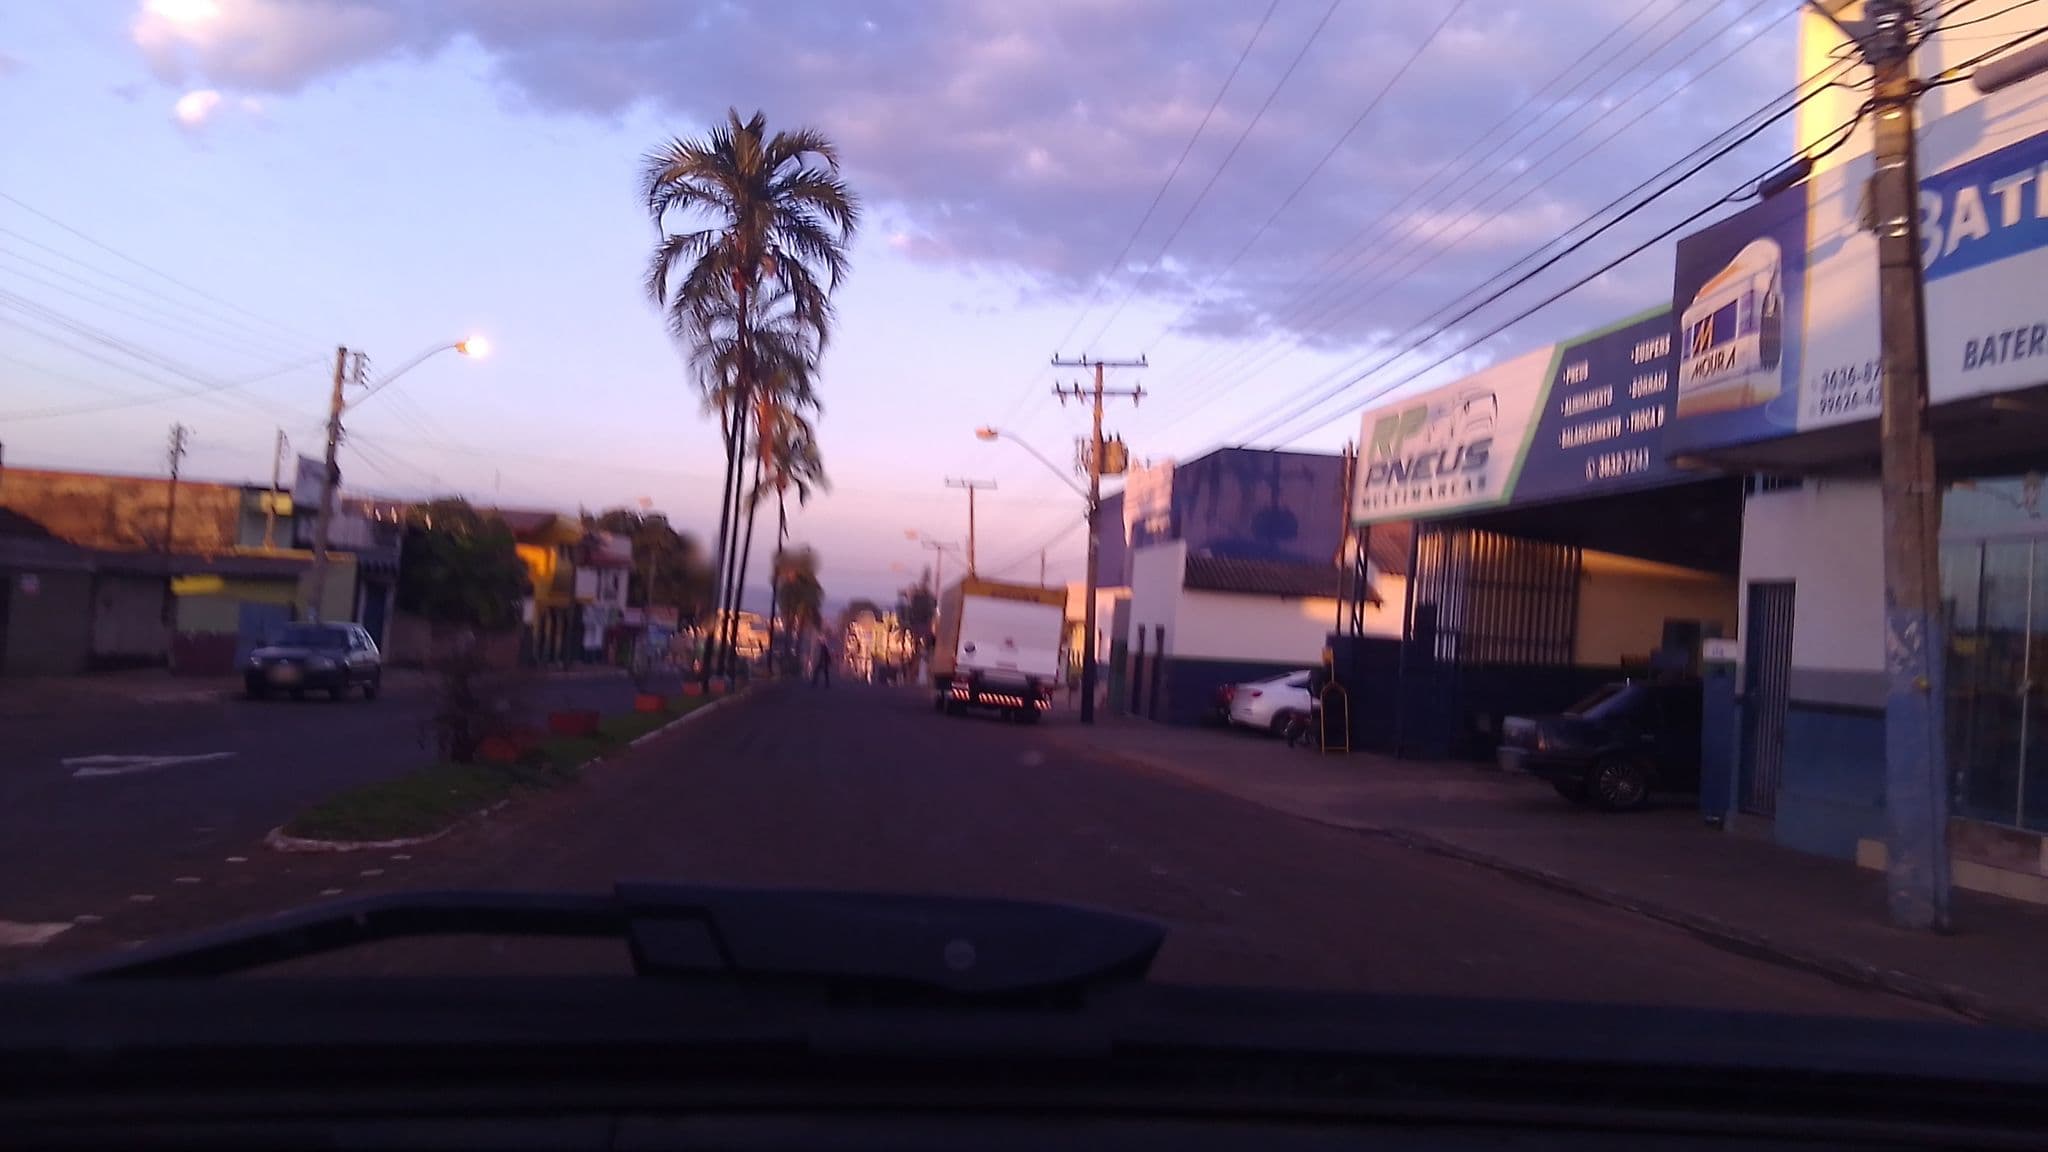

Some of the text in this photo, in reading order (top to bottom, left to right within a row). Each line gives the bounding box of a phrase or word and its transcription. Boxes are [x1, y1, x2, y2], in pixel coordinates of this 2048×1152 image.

[1690, 343, 1737, 381] MOURA
[1630, 405, 1656, 433] TROCA
[1365, 437, 1494, 488] PNEUS
